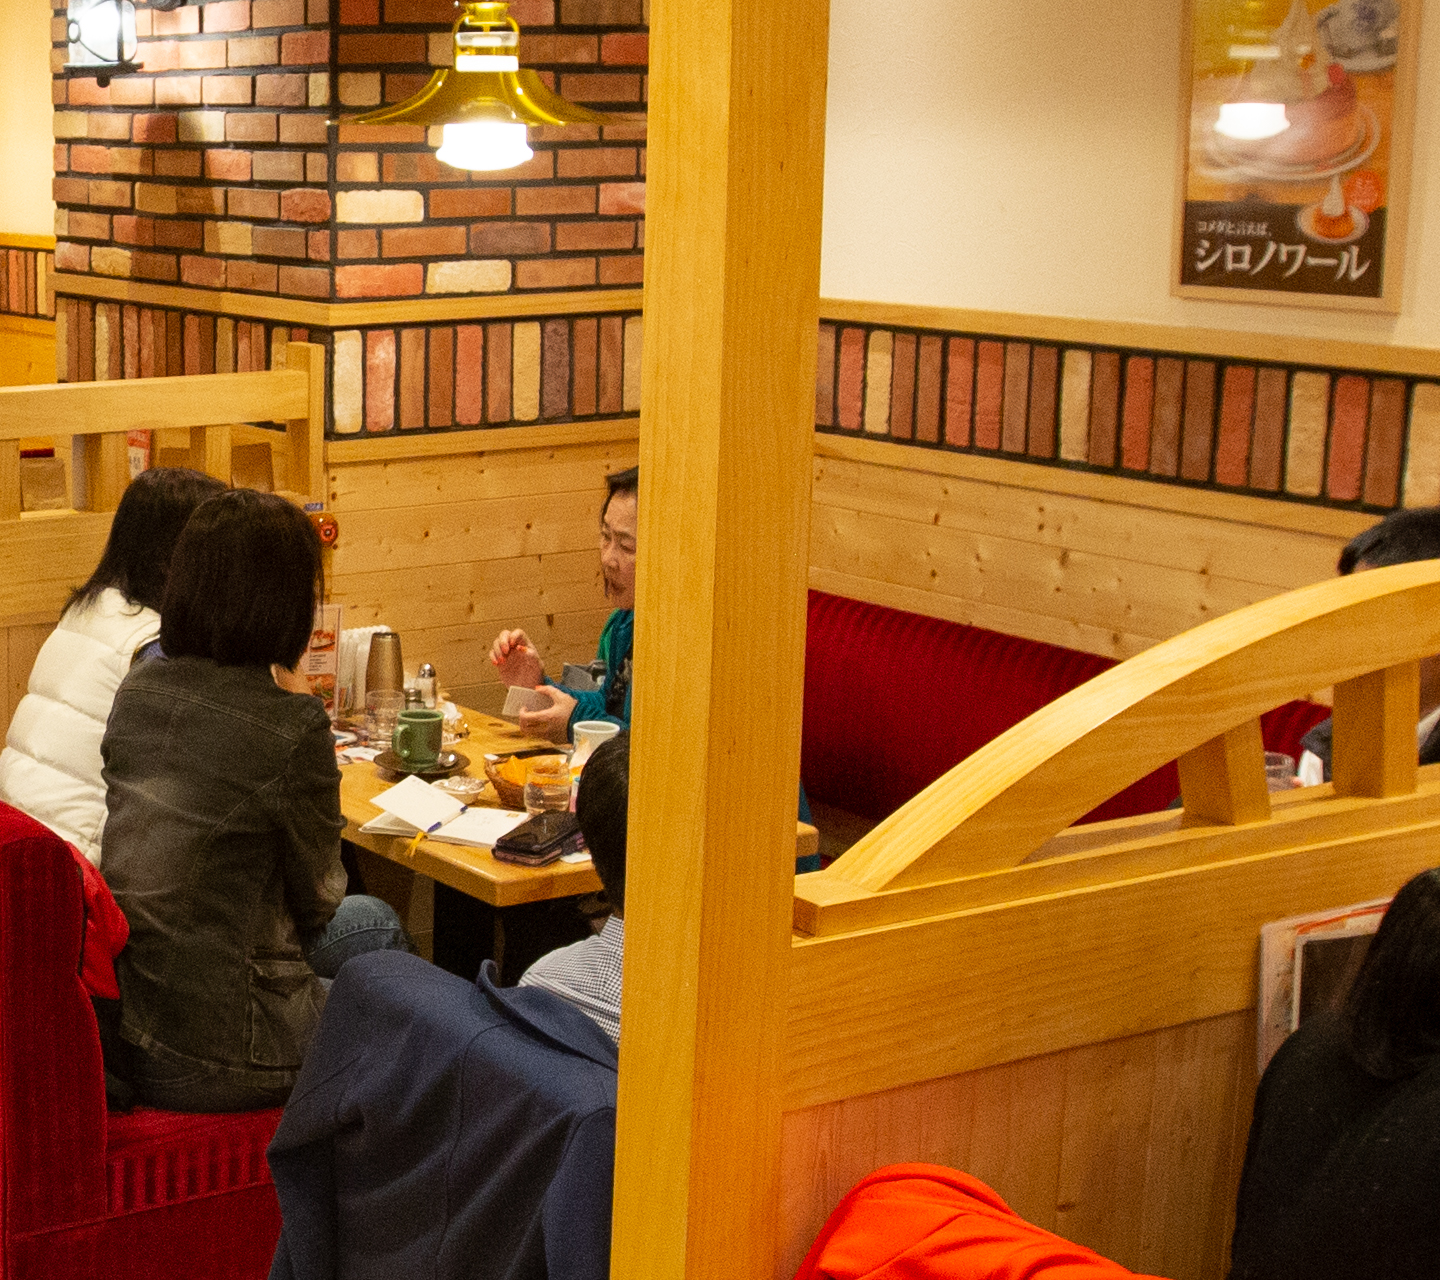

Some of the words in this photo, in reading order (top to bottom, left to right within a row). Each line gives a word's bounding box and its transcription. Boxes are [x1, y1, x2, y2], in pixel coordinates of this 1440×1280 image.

[1194, 239, 1371, 282] シロノワール
